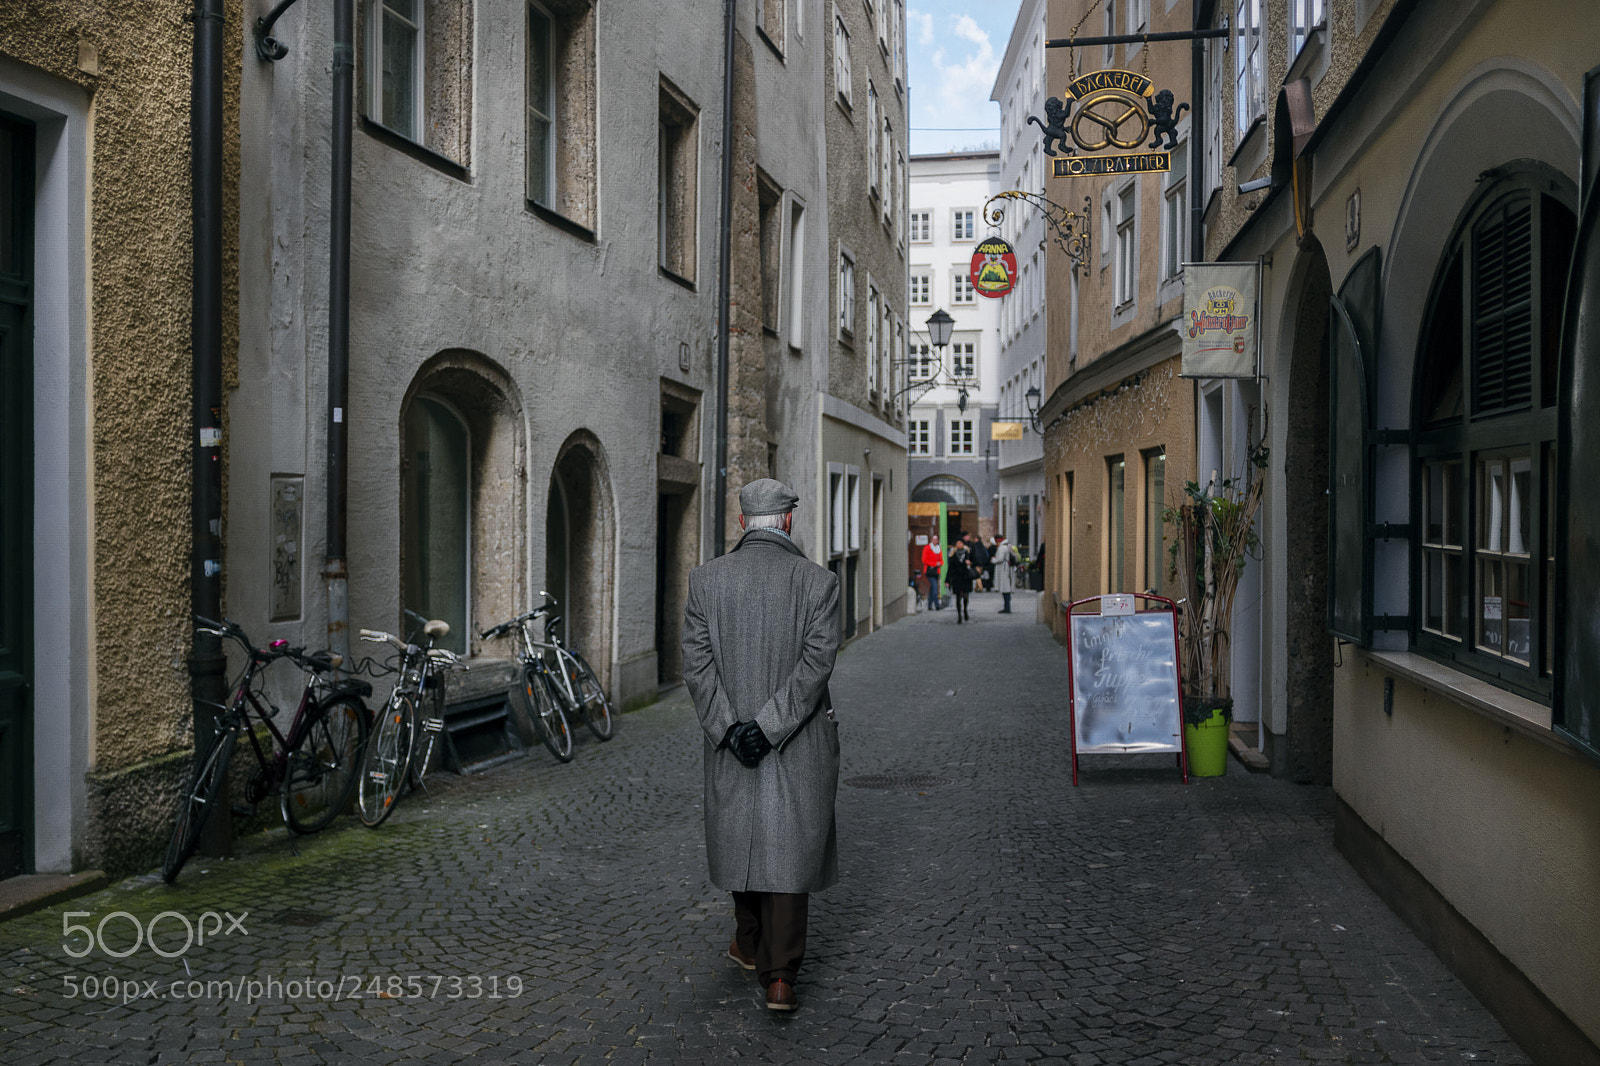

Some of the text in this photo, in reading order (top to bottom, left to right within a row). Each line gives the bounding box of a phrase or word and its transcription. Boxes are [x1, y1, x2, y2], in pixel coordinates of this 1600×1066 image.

[1075, 73, 1144, 95] BÄCKEREI
[1060, 155, 1165, 174] HOLZTRATTNER
[978, 243, 1009, 254] HANNA
